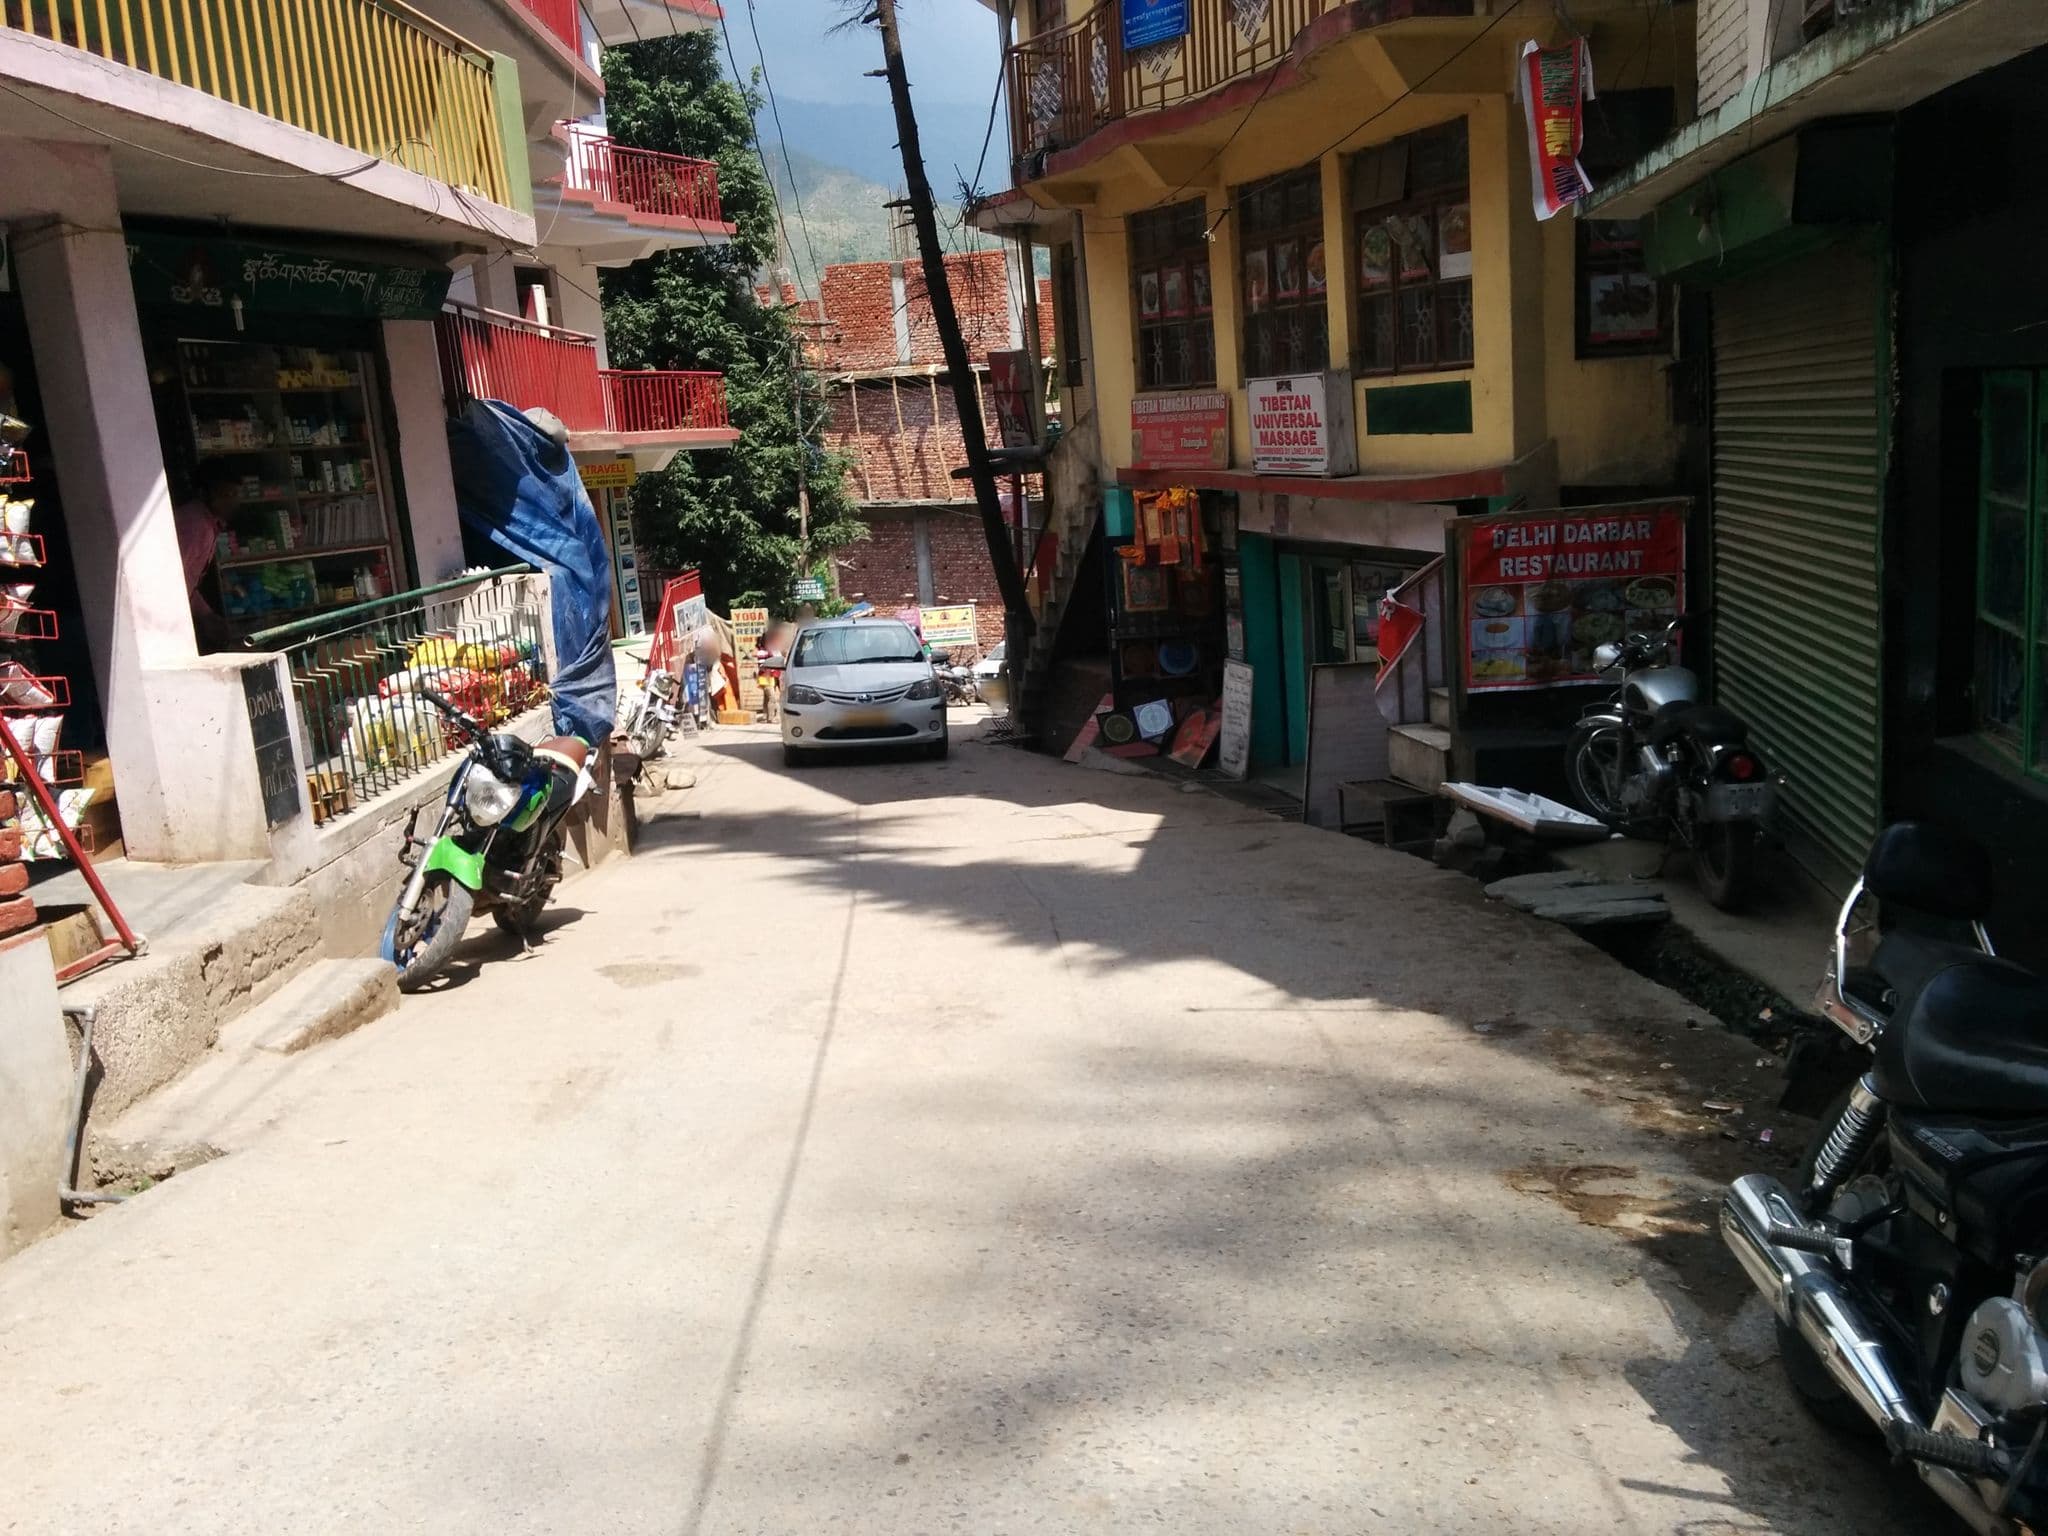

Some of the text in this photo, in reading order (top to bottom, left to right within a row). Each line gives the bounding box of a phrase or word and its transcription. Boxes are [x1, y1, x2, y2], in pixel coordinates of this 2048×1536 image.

[1544, 117, 1573, 156] LUNCH
[1191, 394, 1225, 410] PAINTING
[1259, 394, 1311, 411] TIBETAN
[1254, 412, 1322, 429] UNIVERSAL
[1259, 430, 1317, 446] MASSAGE
[1492, 520, 1651, 549] DELHI DARBAR
[1499, 550, 1643, 577] RESTAURANT
[735, 611, 764, 621] YOGA
[248, 688, 284, 720] DOMA
